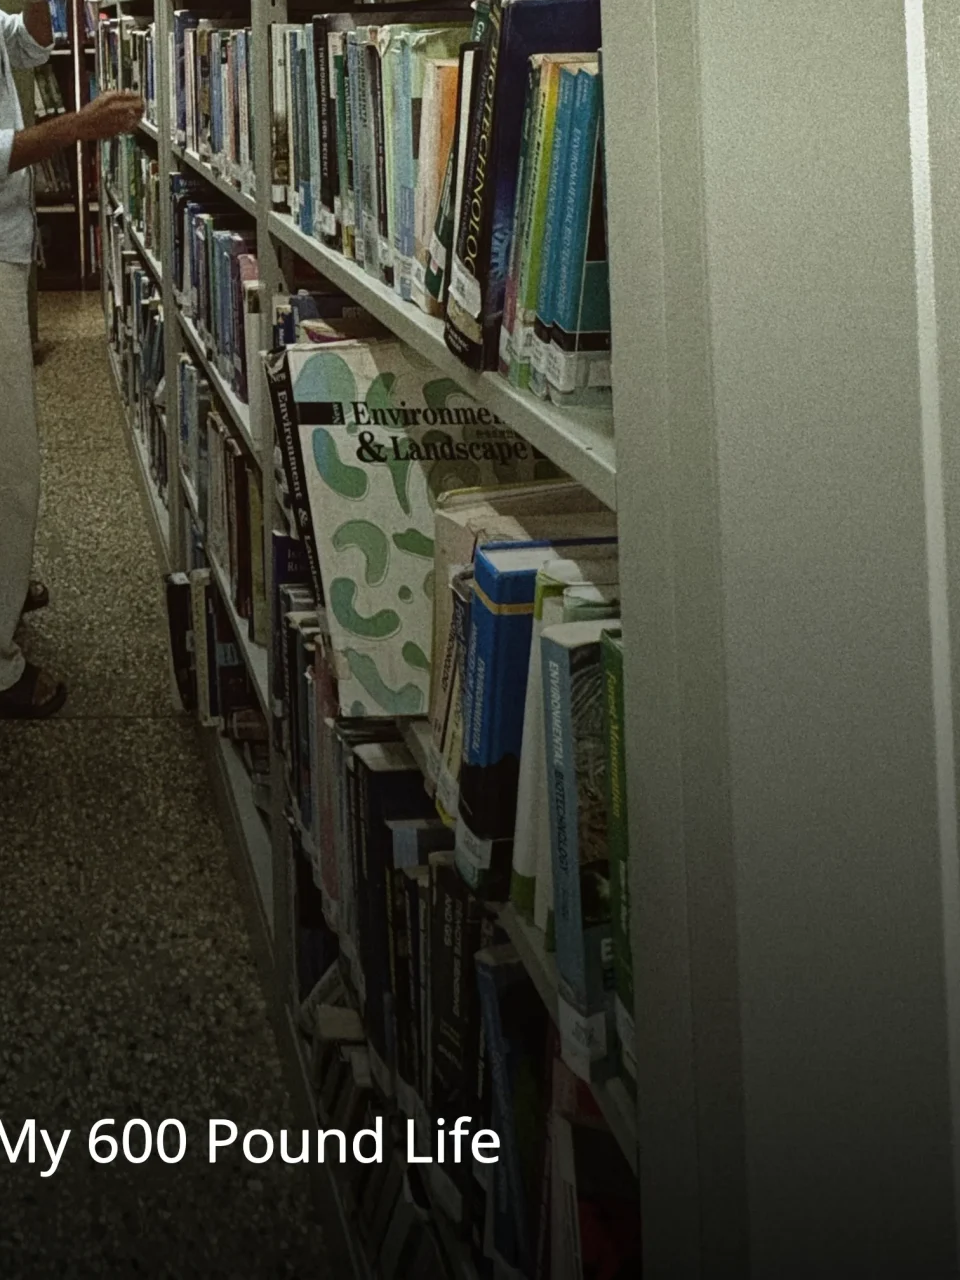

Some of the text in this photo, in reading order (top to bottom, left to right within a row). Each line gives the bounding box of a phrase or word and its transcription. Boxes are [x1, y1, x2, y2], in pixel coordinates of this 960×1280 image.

[350, 400, 507, 426] Environme
[356, 430, 529, 465] & Landscape
[548, 659, 564, 767] ENVIRONMENTAL
[554, 768, 569, 872] BIOTECHNOLOGY
